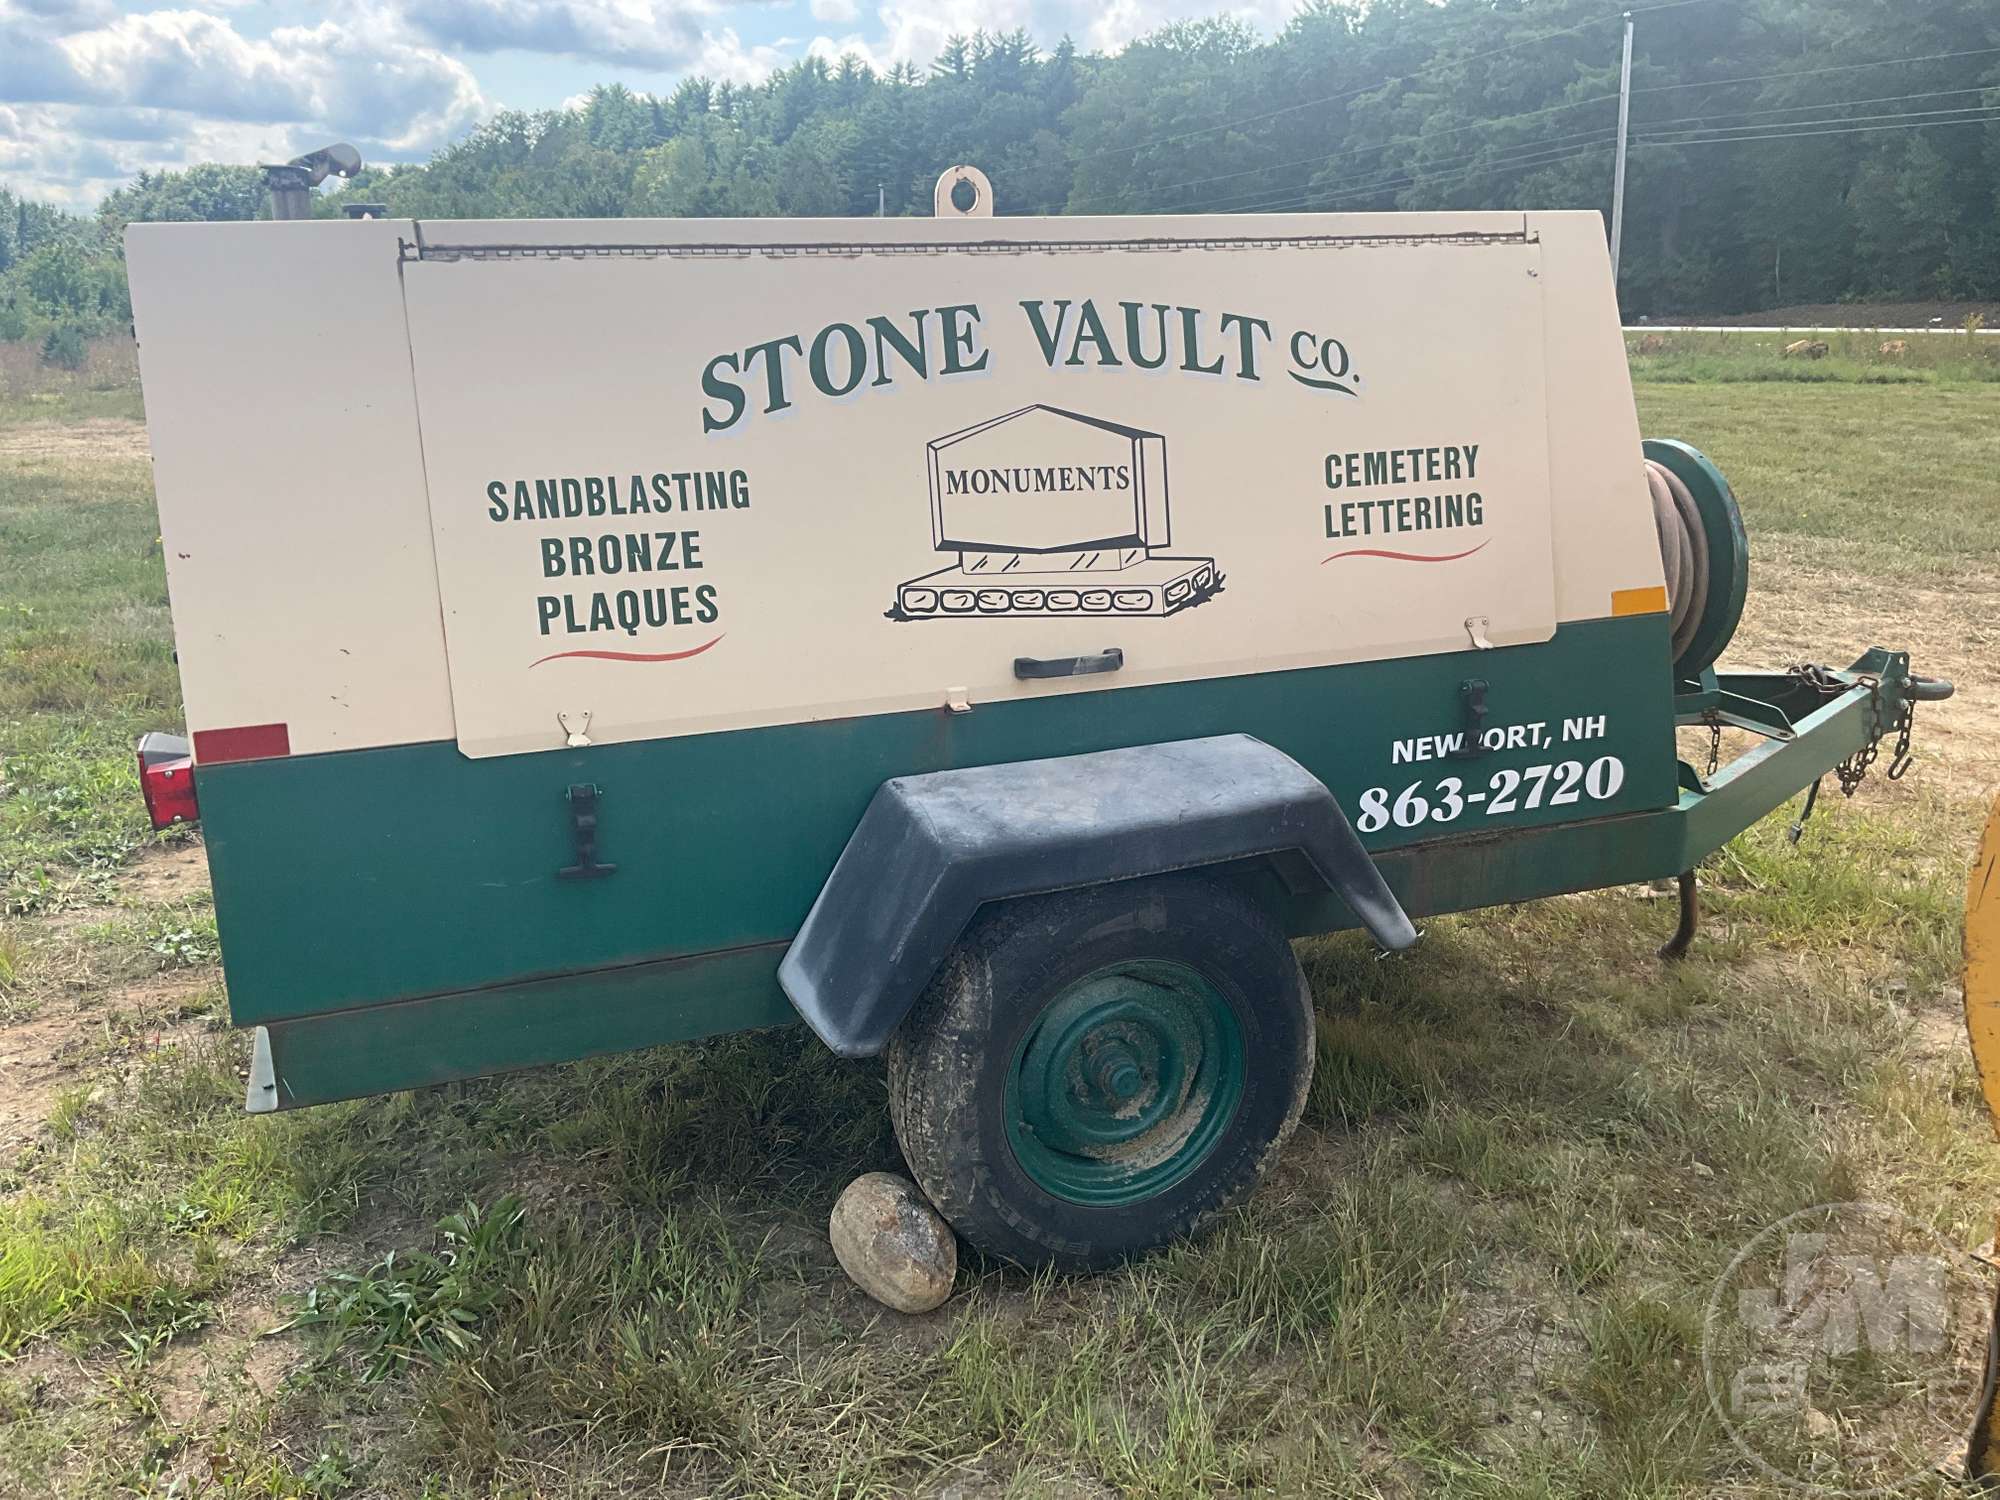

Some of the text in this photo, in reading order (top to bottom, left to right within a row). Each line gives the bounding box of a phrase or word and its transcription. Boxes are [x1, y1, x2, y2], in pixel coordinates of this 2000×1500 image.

[700, 298, 1360, 434] STONE VAULT CO.
[945, 465, 1130, 495] MONUMENTS
[1324, 444, 1479, 489] CEMETERY
[486, 469, 751, 522] SANDBLASTING
[1324, 492, 1484, 538] LETTERING
[540, 530, 704, 578] BRONZE
[536, 584, 719, 636] PLAQUES
[1391, 714, 1607, 765] NEWORT, NH
[1355, 754, 1625, 834] 863-2720
